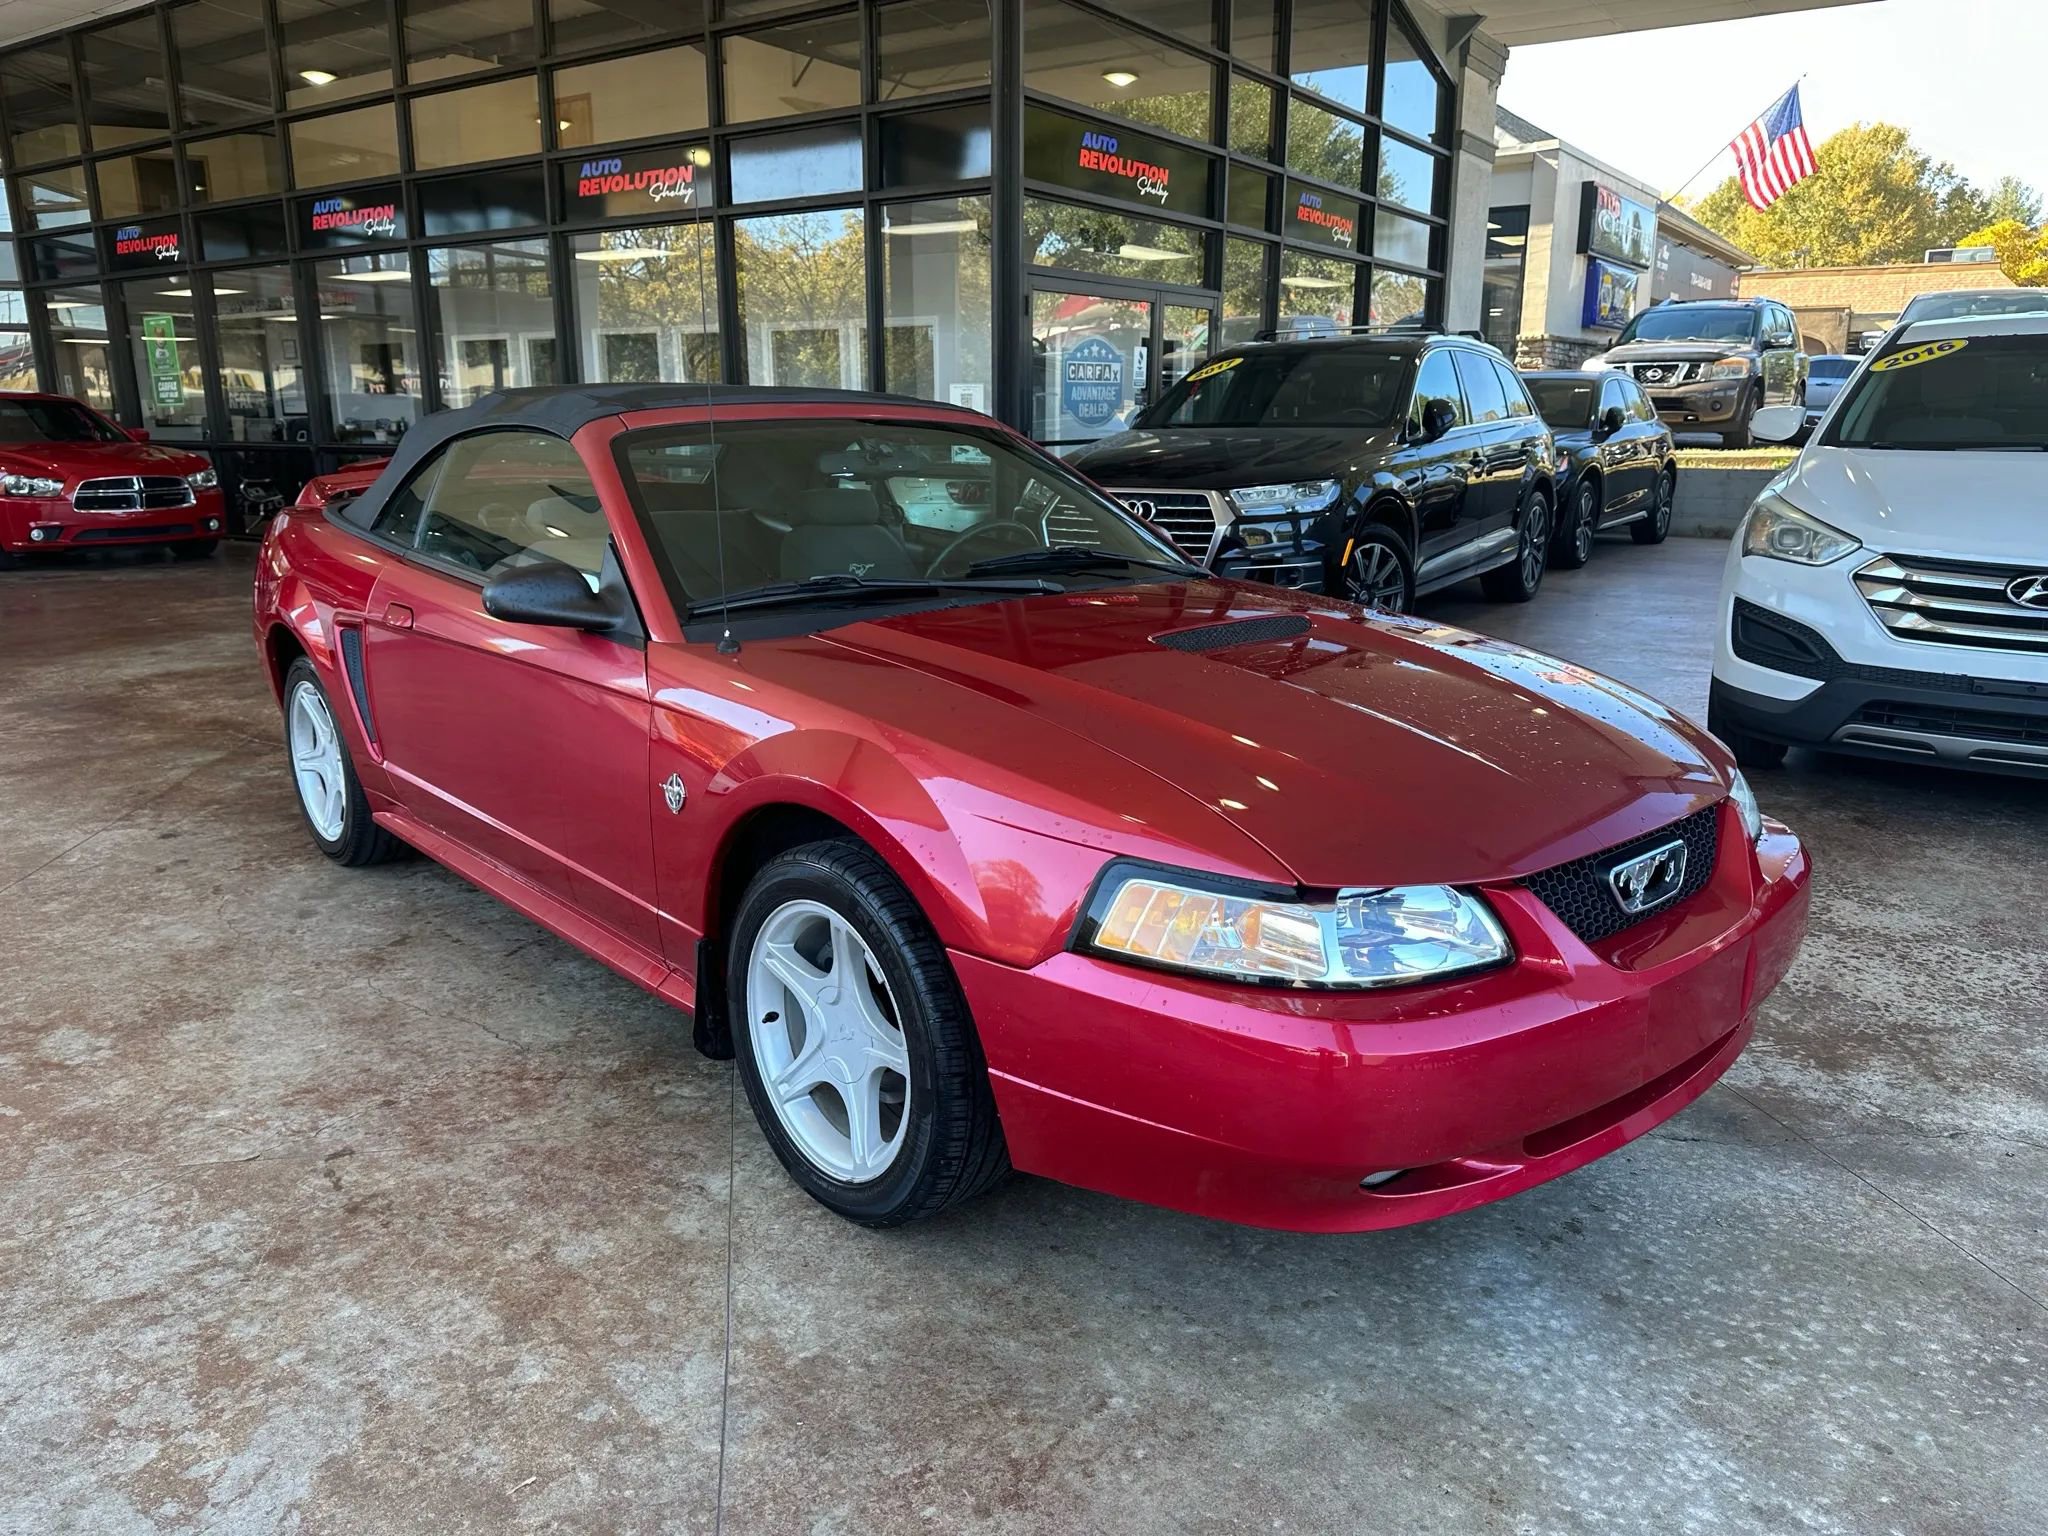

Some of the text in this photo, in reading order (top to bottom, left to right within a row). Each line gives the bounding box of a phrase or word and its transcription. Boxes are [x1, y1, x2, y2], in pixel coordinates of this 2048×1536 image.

[1082, 132, 1118, 153] AUTO
[580, 159, 622, 177] AUTO
[1080, 149, 1169, 185] REVOLUTION
[579, 165, 693, 197] REVOLUTION
[649, 178, 694, 204] Shelby
[1137, 176, 1168, 205] Shelby
[313, 199, 341, 215] AUTO
[1300, 192, 1322, 209] AUTO
[312, 204, 395, 230] REVOLUTION
[364, 216, 396, 237] Shelby
[1297, 205, 1353, 234] REVOLUTION
[116, 233, 178, 255] REVOLUTION
[117, 228, 140, 241] AUTO
[1884, 342, 1956, 368] 2016
[1068, 363, 1120, 382] CARFAX
[1071, 386, 1117, 400] ADVANTAGE
[1079, 402, 1109, 417] DEALER
